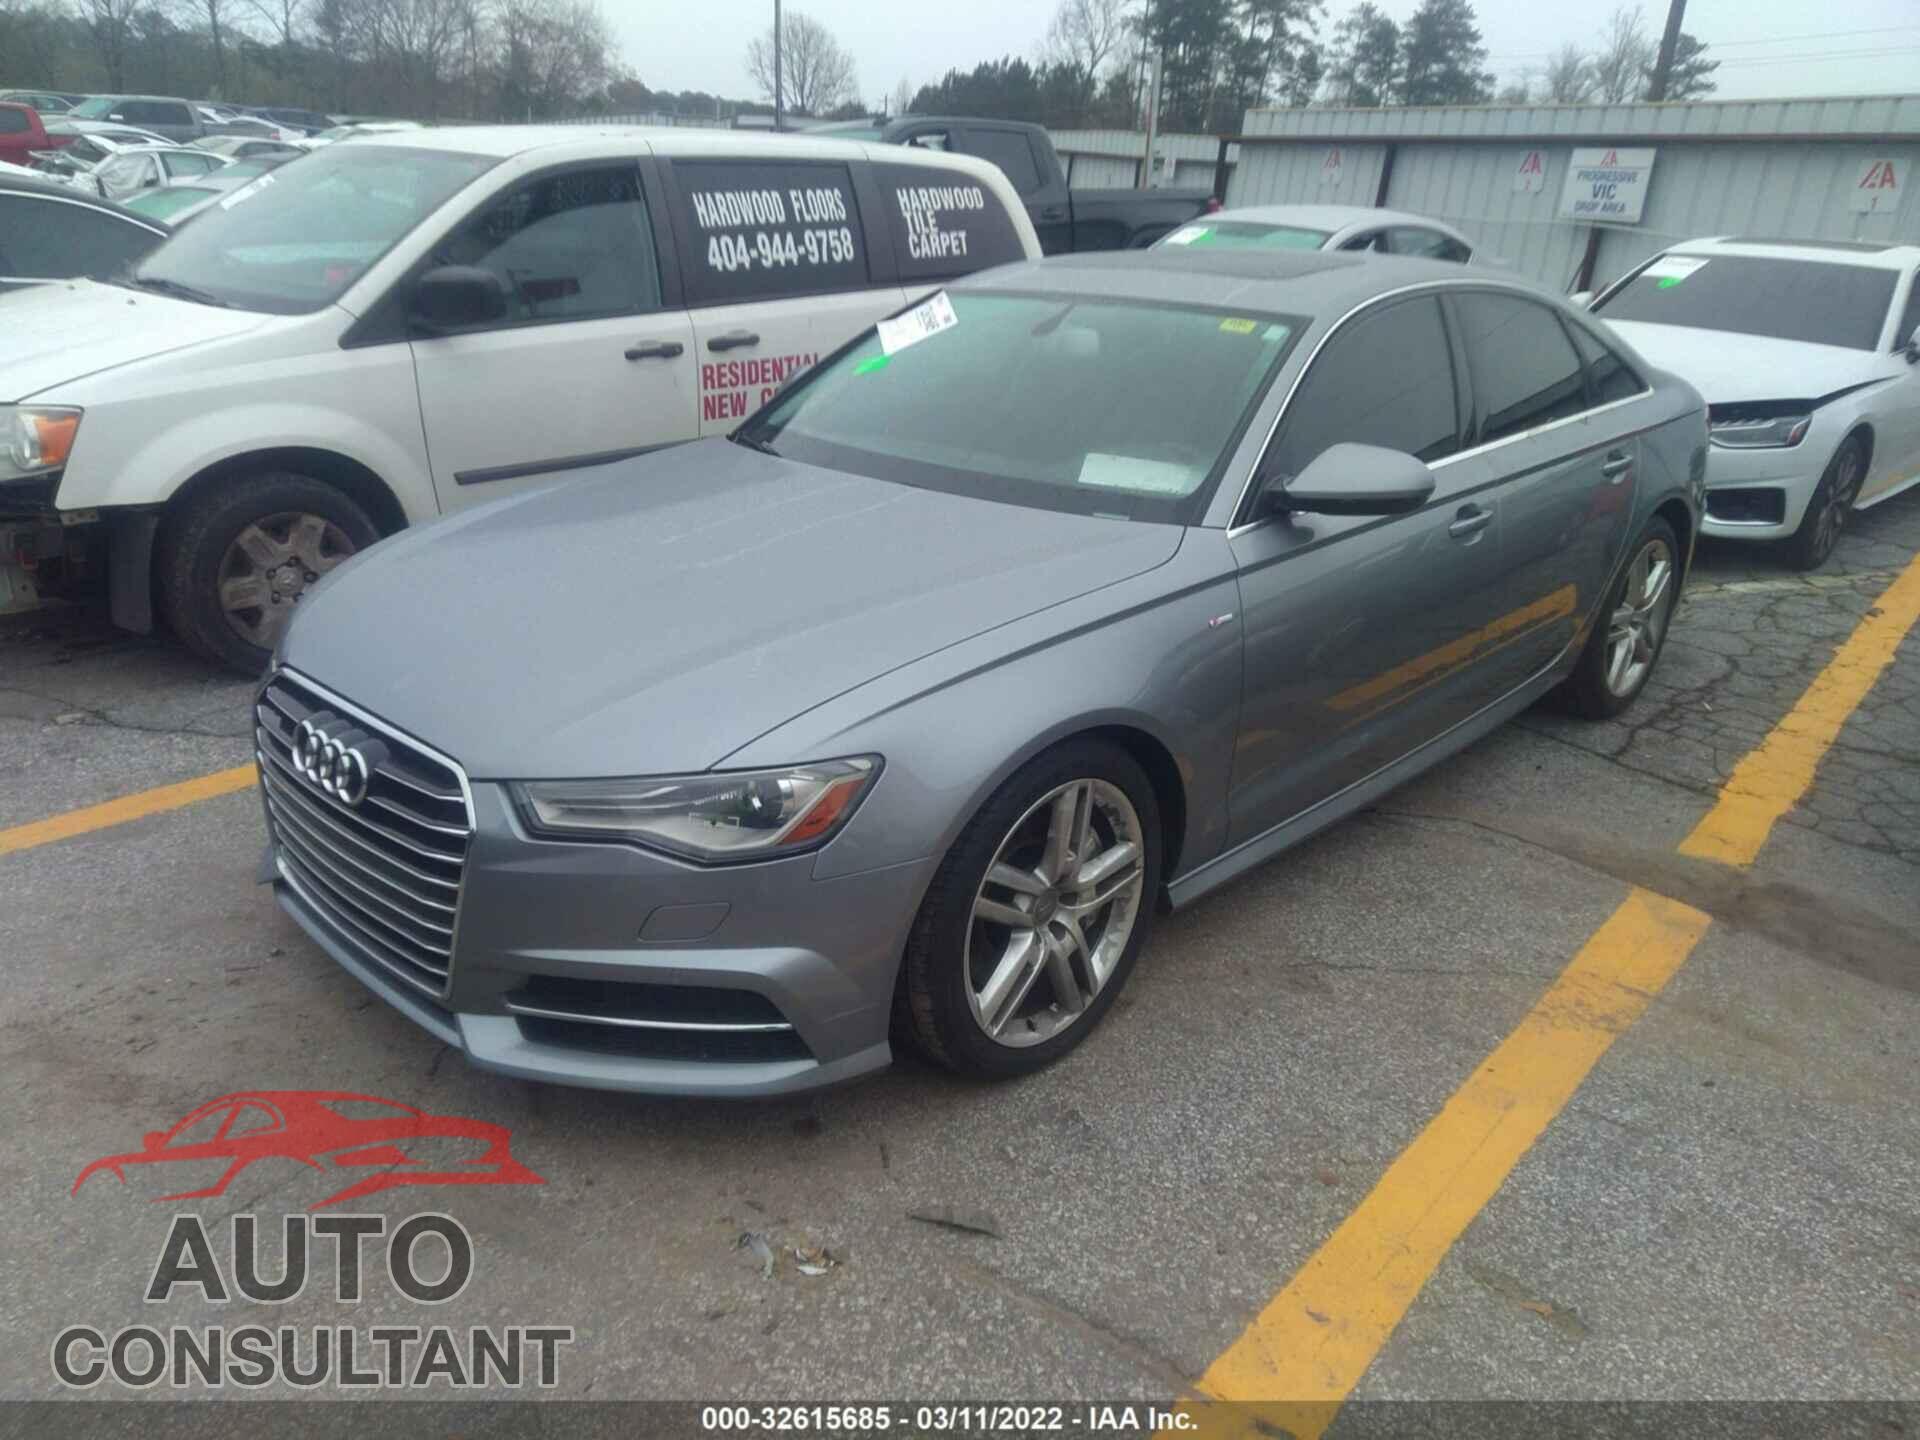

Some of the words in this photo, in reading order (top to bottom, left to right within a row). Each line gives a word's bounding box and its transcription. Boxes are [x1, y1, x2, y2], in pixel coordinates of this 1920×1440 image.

[896, 187, 984, 211] HARDWOOD
[1592, 183, 1617, 200] VIC
[692, 189, 786, 228] HARDWOOD
[789, 188, 847, 222] FLOORS
[708, 227, 854, 272] 404-944-9758
[908, 230, 967, 259] CARPET
[703, 392, 747, 421] NEW
